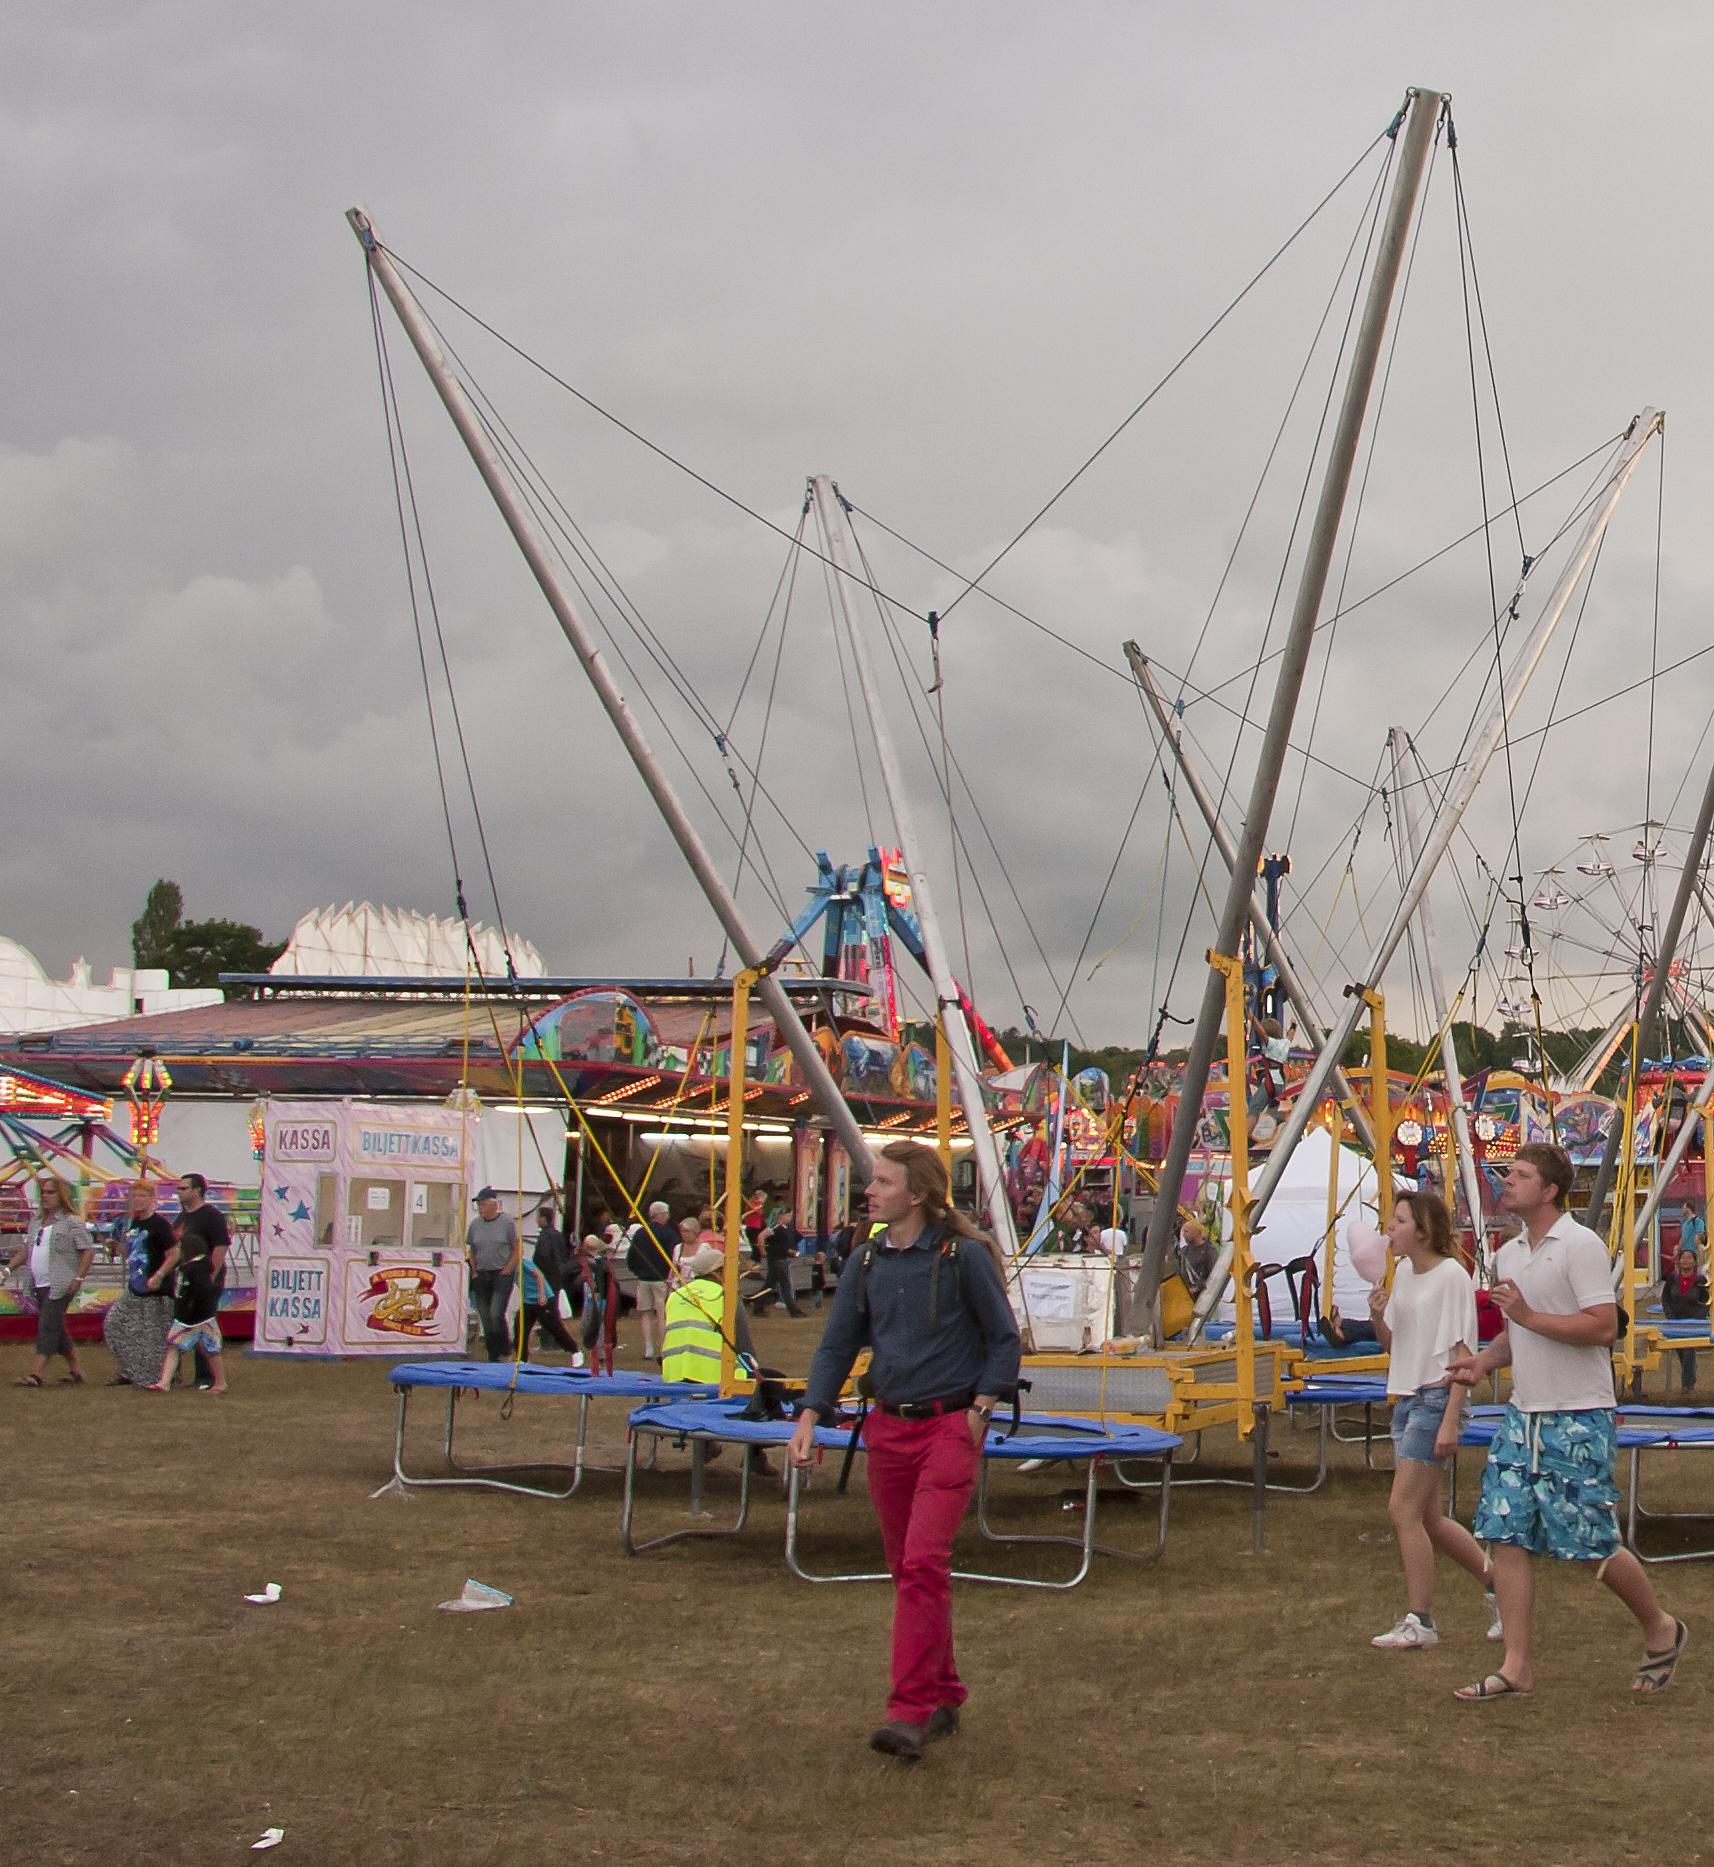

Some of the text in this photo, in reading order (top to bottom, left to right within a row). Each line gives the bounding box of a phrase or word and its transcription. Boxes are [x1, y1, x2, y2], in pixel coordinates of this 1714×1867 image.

[278, 1128, 331, 1150] KASSA
[270, 1269, 324, 1294] BILJETT
[269, 1296, 321, 1319] KASSA
